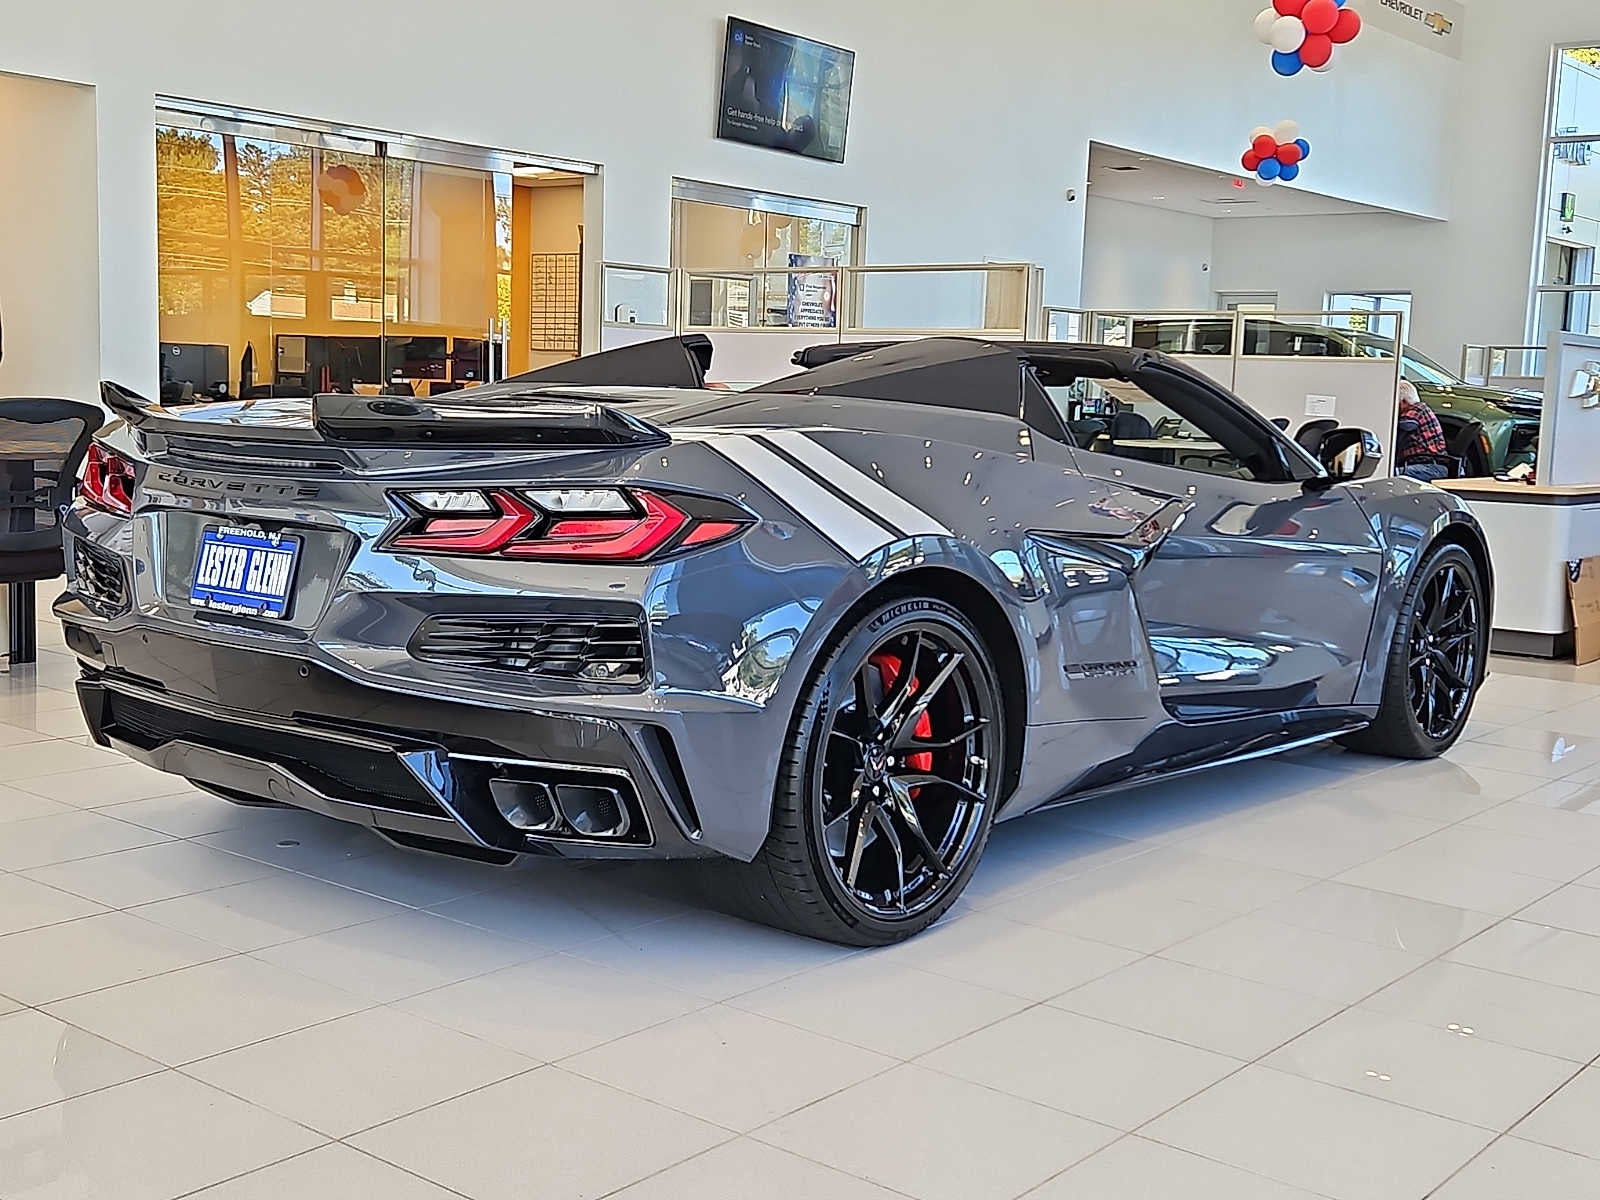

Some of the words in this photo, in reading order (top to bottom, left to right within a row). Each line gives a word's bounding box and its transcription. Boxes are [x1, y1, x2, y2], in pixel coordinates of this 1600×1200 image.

[1380, 0, 1423, 20] CHEVROLET
[158, 471, 320, 497] CORVETTE
[218, 526, 266, 541] FREEHOLD,
[268, 531, 282, 542] NJ
[198, 544, 248, 590] LESTER
[245, 550, 293, 597] GLENN
[882, 601, 929, 623] MICHELIN
